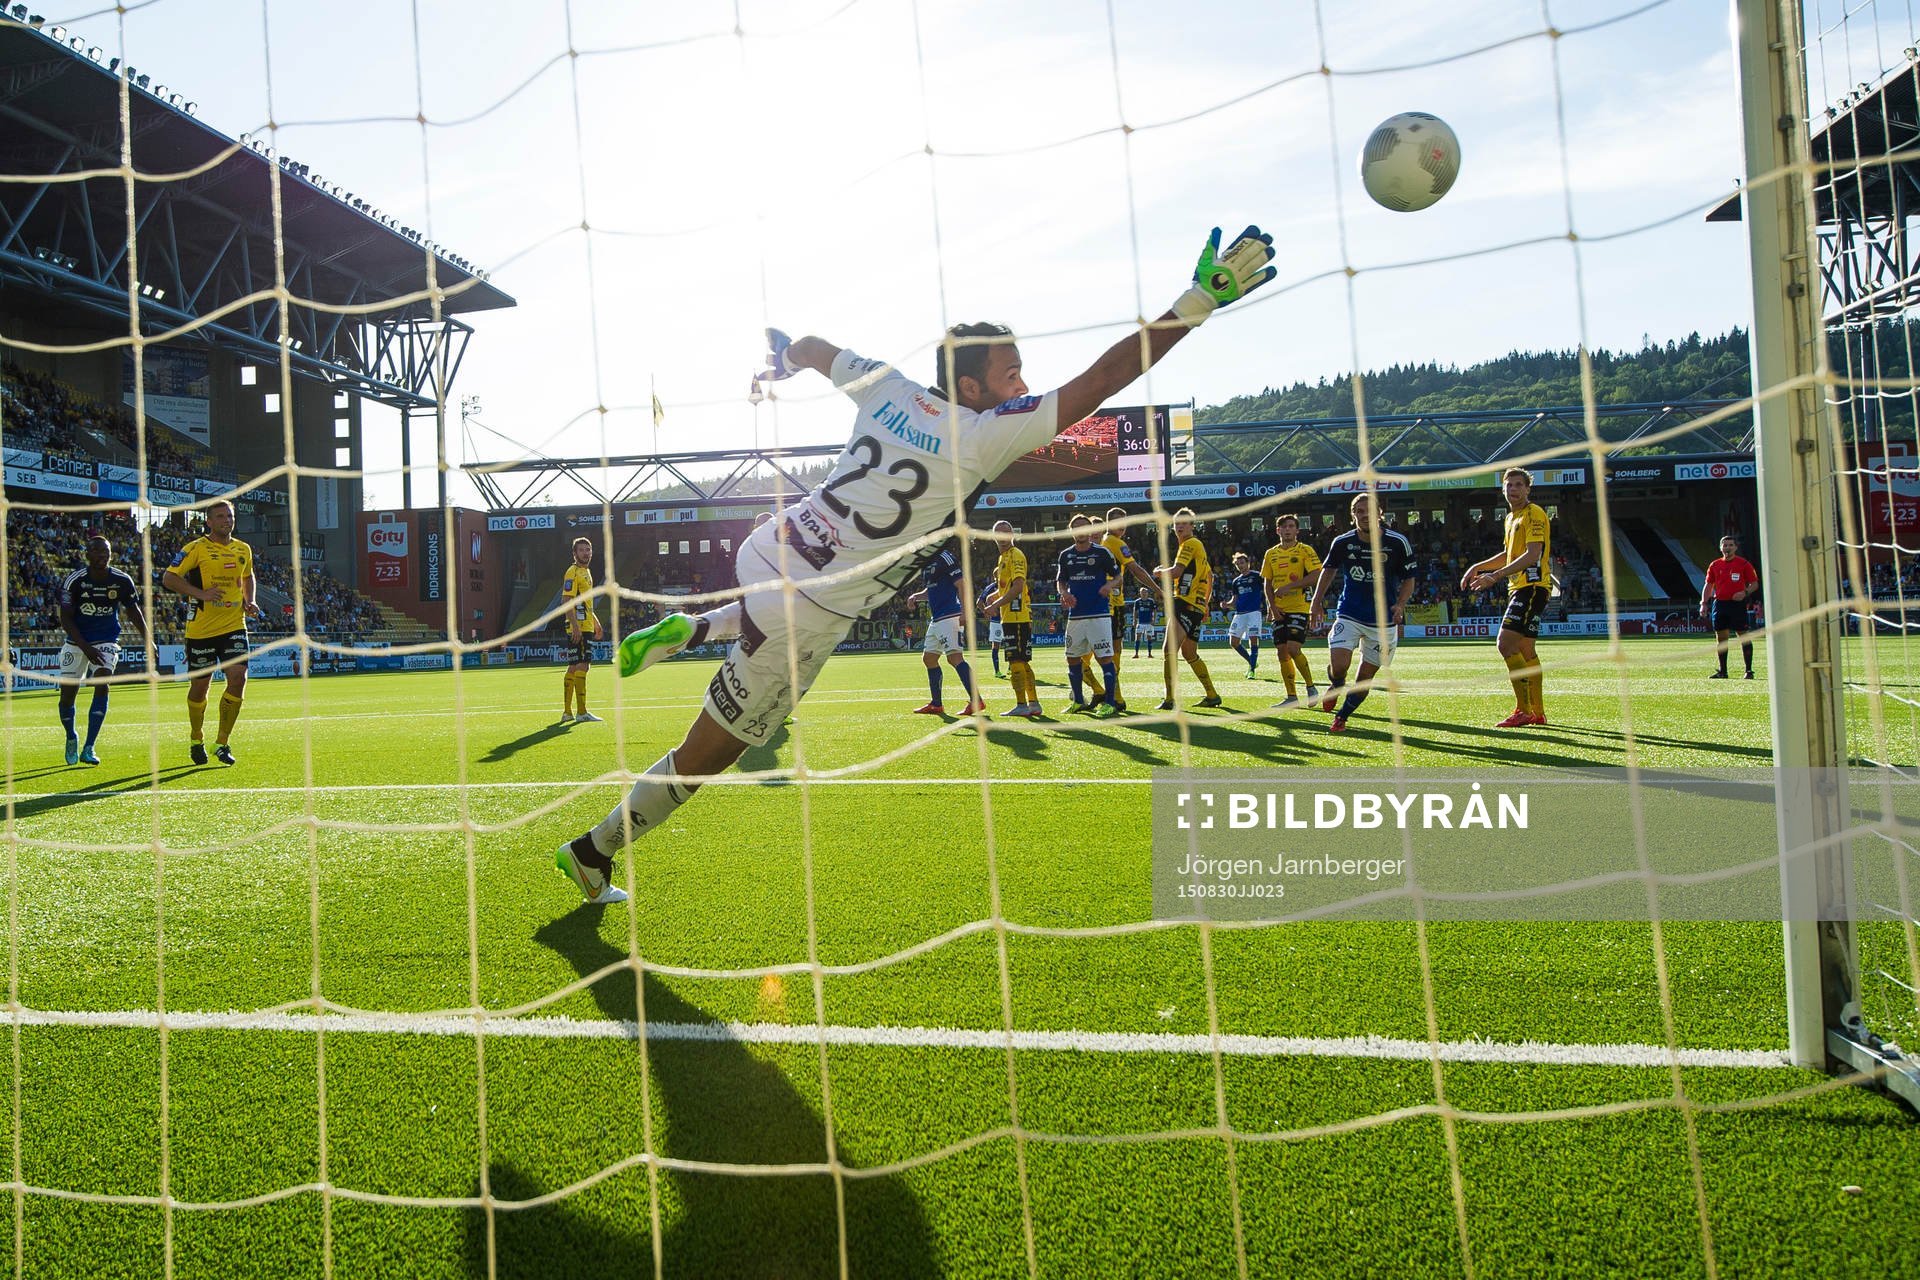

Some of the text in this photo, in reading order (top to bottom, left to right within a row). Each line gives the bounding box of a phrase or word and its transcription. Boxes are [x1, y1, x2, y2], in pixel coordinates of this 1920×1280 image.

[871, 399, 942, 456] Folksam
[16, 472, 37, 485] SEB
[1614, 469, 1662, 478] SOHLBERG
[821, 434, 930, 540] 23
[1198, 486, 1225, 498] Sjuhärad
[1244, 482, 1276, 497] ellos
[999, 493, 1064, 505] Swedbank Sjuhärad
[1078, 490, 1144, 501] Swedbank Sjuhärad
[375, 566, 401, 577] 7-23
[428, 532, 440, 599] DIDRIKSONS
[1426, 626, 1488, 636] CRAMO
[1659, 623, 1707, 633] rörvikshus
[742, 719, 768, 738] 23
